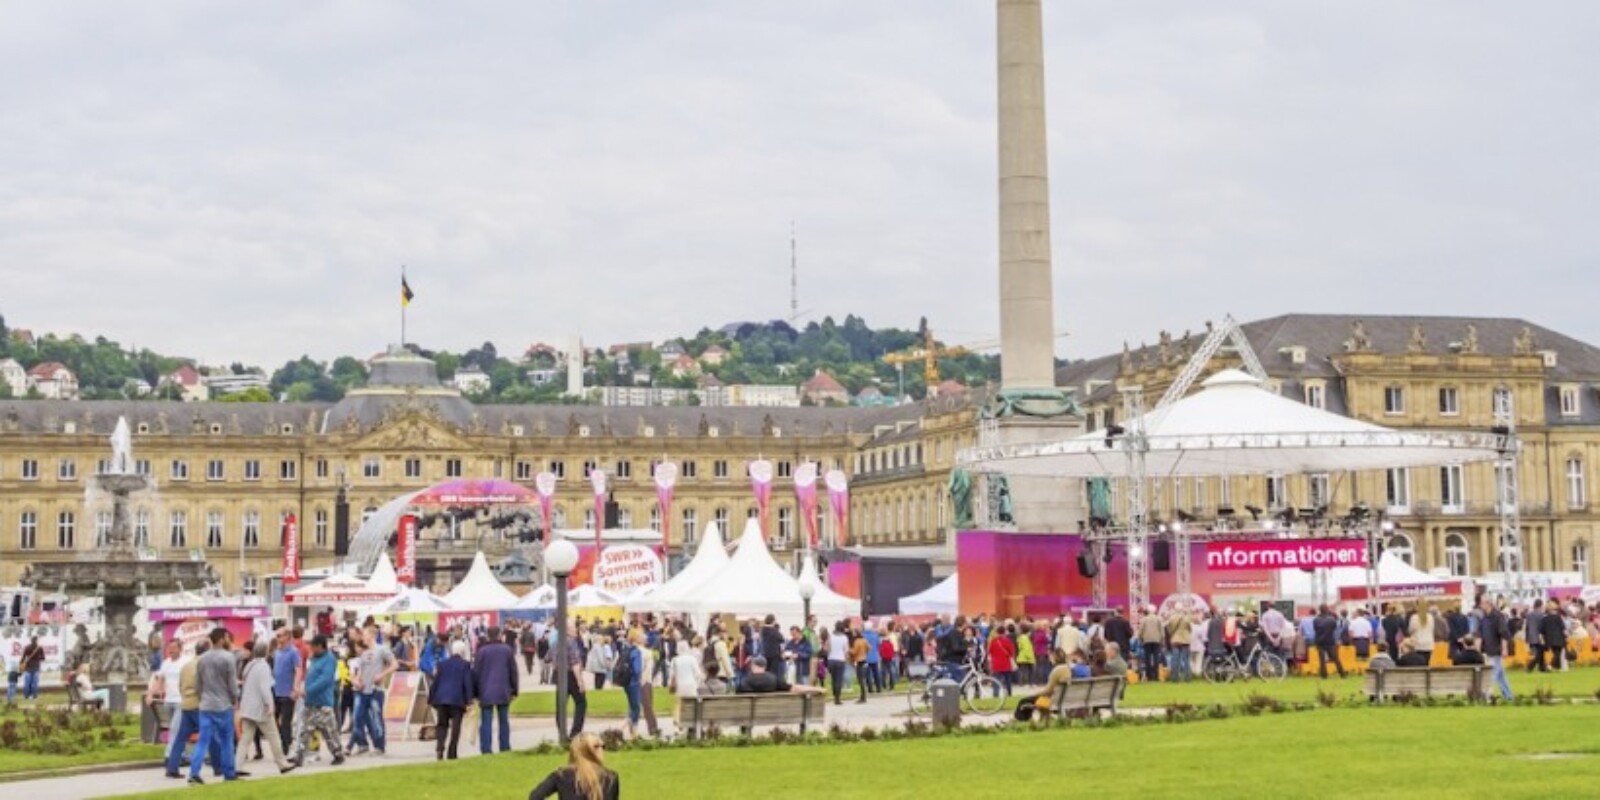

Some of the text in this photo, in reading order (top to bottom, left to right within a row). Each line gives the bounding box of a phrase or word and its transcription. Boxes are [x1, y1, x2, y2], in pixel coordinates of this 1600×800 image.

[284, 522, 297, 578] Rothaus
[397, 521, 415, 577] Rothaus
[1207, 545, 1357, 567] nformationen
[598, 560, 654, 578] Sommer
[604, 570, 655, 590] festival
